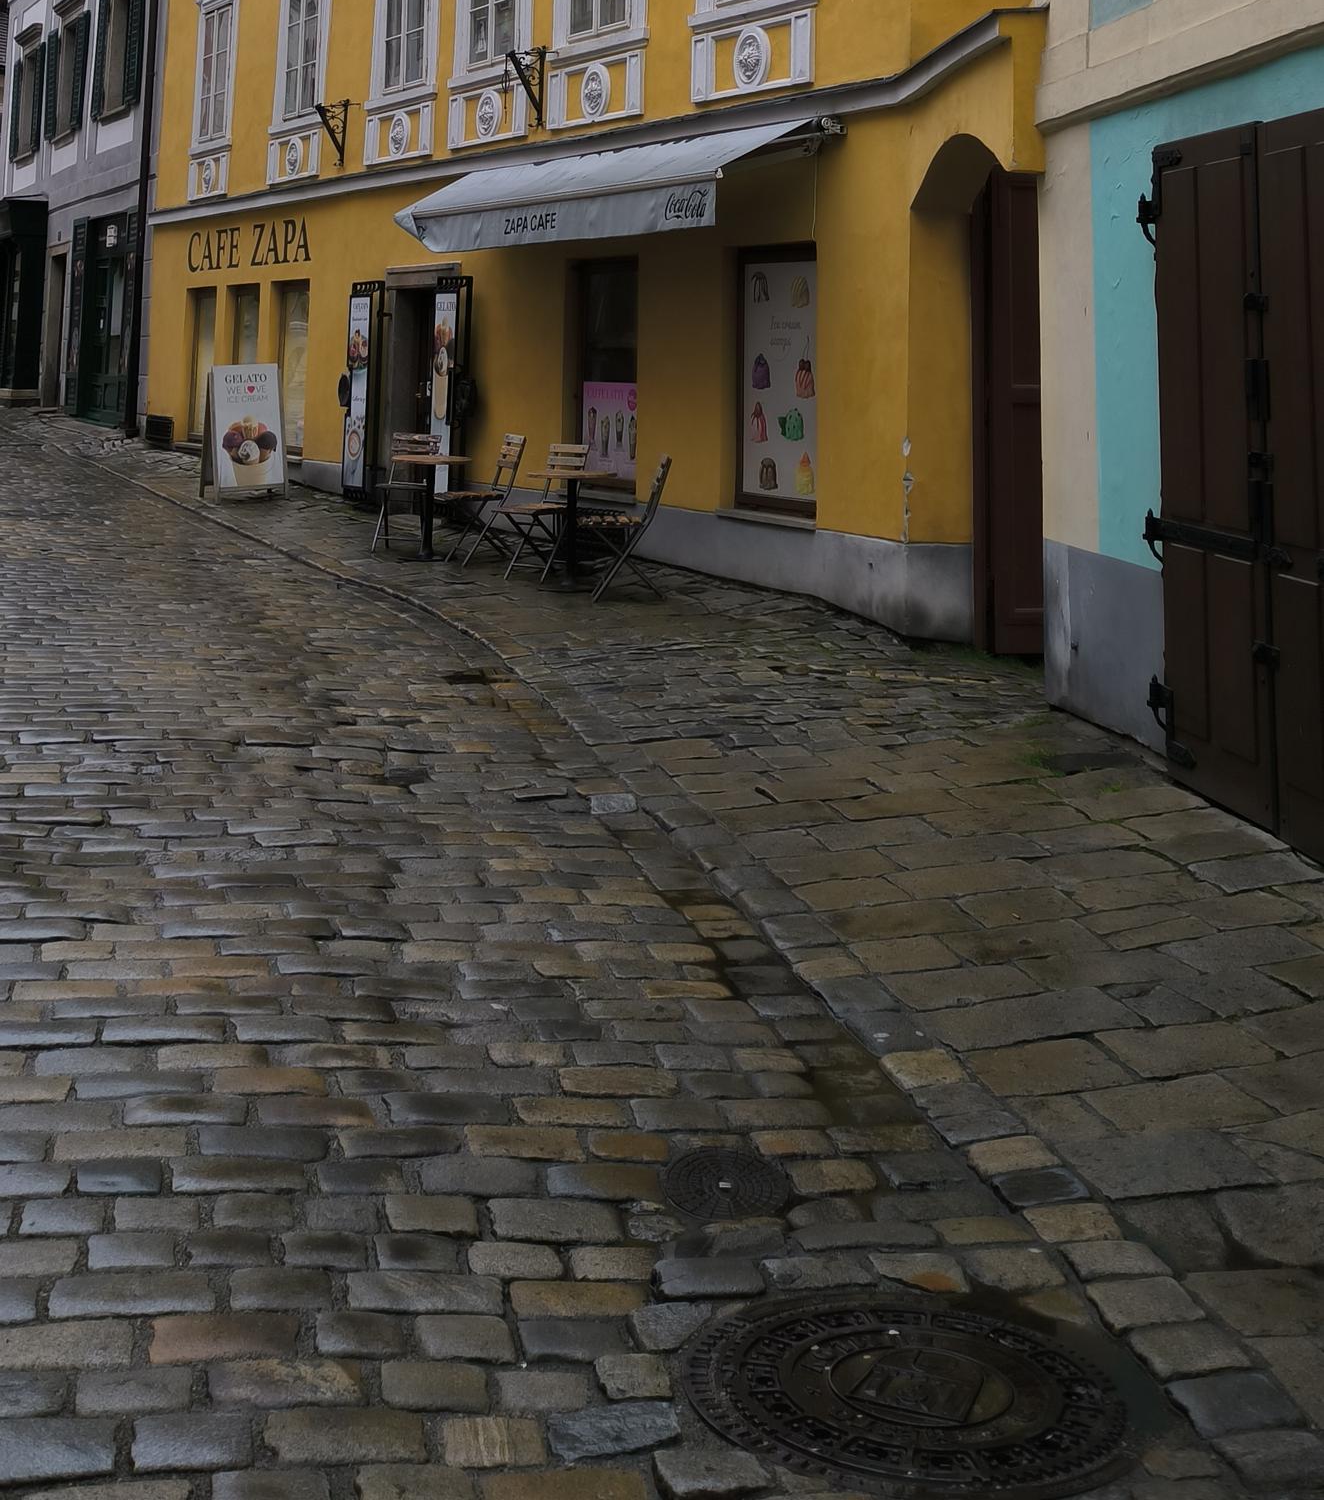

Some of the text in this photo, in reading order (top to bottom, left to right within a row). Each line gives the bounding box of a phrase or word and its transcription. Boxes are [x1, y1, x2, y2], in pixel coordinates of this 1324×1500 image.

[504, 212, 557, 235] ZAPA CAFE
[187, 226, 241, 273] CAFE
[251, 215, 312, 267] ZAPA
[225, 373, 267, 384] GELATO
[226, 385, 241, 395] WE
[241, 395, 268, 403] CREAM
